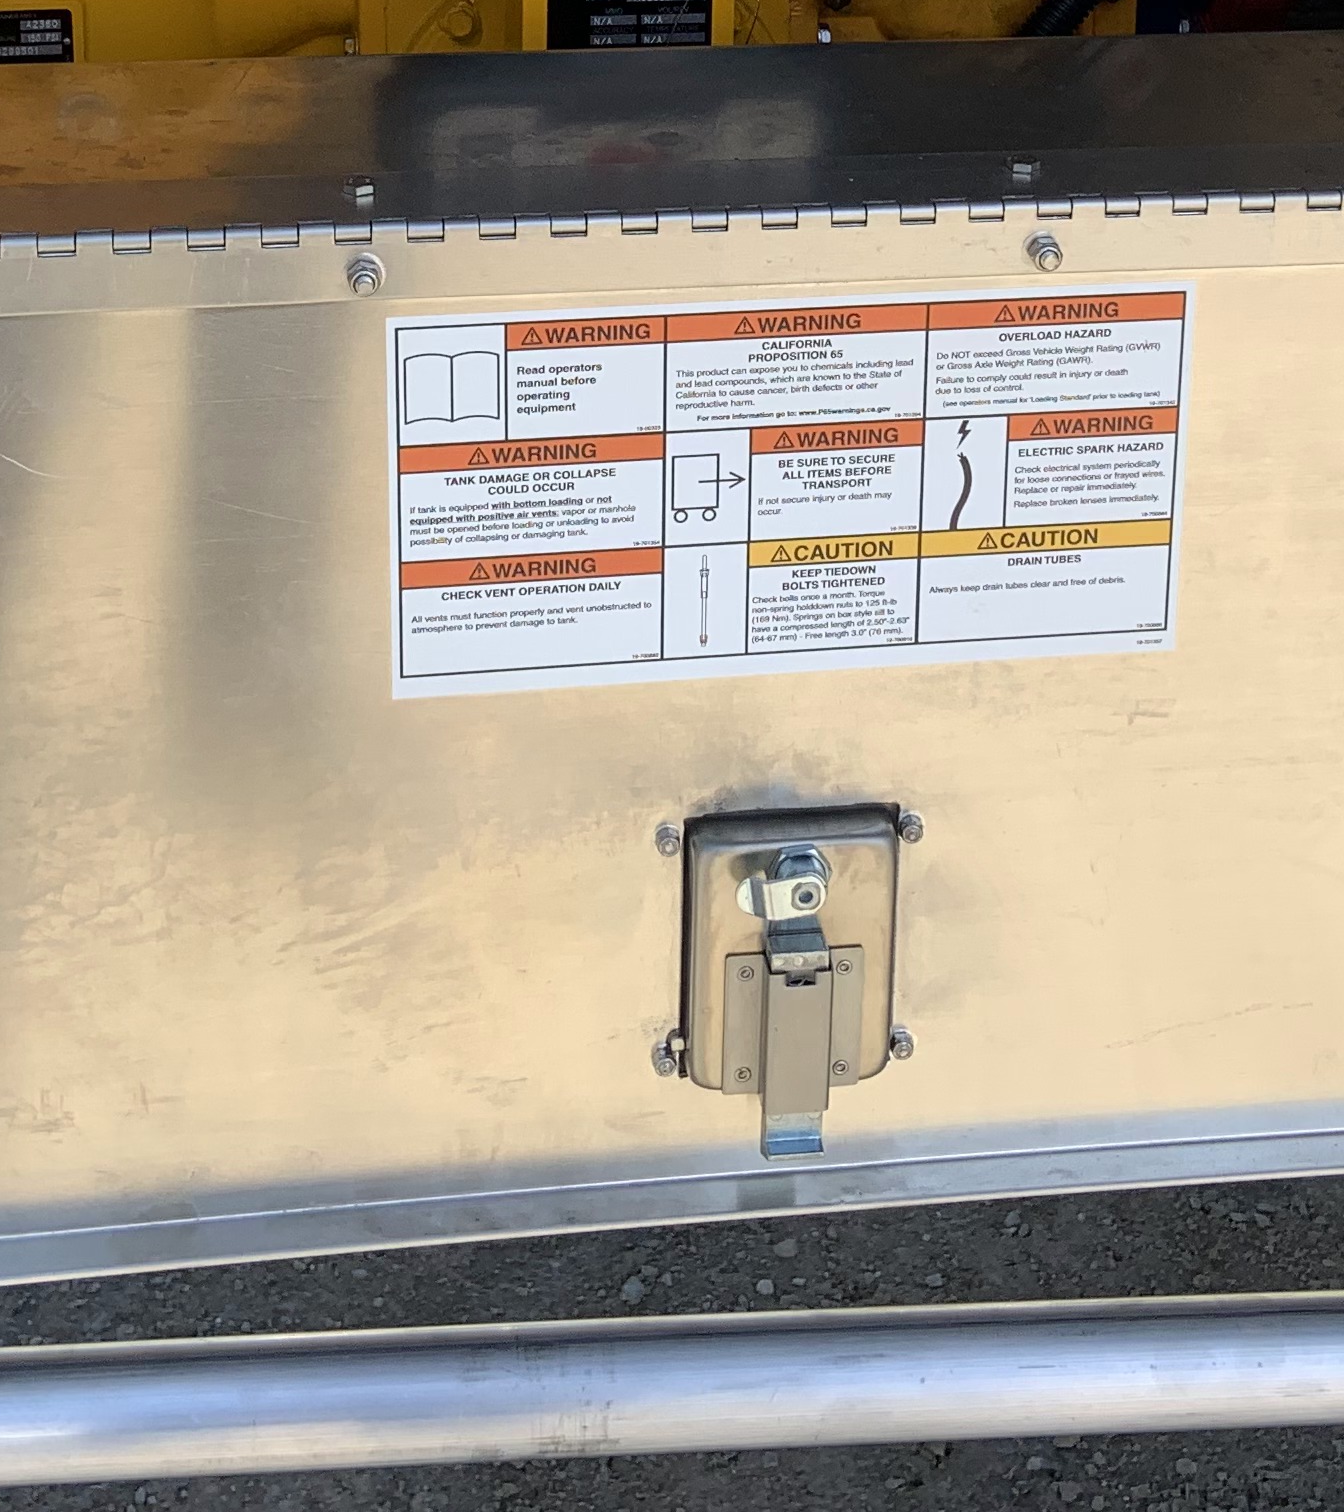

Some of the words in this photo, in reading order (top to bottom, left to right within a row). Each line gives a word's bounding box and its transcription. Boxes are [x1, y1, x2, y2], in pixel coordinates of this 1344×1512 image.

[643, 16, 663, 24] N/A
[593, 37, 613, 45] N/A
[643, 36, 664, 44] N/A
[1016, 300, 1119, 322] WARNING
[758, 312, 861, 334] WARNING
[544, 322, 651, 344] WARNING
[998, 329, 1062, 342] OVERLOAD
[1063, 327, 1112, 339] HAZARD
[761, 337, 833, 351] CALIFORNIA
[747, 349, 827, 363] PROPOSITION
[829, 349, 843, 359] 65
[516, 364, 545, 375] Read
[548, 362, 602, 376] operators
[516, 376, 557, 388] manual
[560, 374, 596, 386] before
[516, 389, 570, 403] operating
[516, 401, 576, 416] equipment
[1052, 414, 1154, 435] WARNING
[795, 426, 899, 448] WARNING
[491, 441, 597, 464] WARNING
[1017, 445, 1074, 458] ELECTRIC
[1076, 443, 1114, 455] SPARK
[1116, 441, 1164, 453] HAZARD
[778, 458, 794, 468] BE
[796, 456, 829, 468] SURE
[829, 455, 846, 466] TO
[848, 453, 895, 465] SECURE
[443, 475, 476, 486] TANK
[478, 472, 529, 484] DAMAGE
[532, 471, 550, 481] OR
[553, 467, 616, 480] COLLAPSE
[781, 469, 804, 480] ALL
[806, 467, 842, 479] ITEMS
[844, 464, 892, 477] BEFORE
[487, 483, 529, 496] COULD
[531, 481, 574, 493] OCCUR
[801, 477, 872, 490] TRANSPORT
[757, 497, 764, 505] If
[765, 496, 779, 505] not
[780, 496, 810, 504] secure
[811, 493, 835, 504] injury
[836, 493, 846, 501] or
[847, 491, 872, 500] death
[873, 491, 892, 501] may
[999, 527, 1098, 549] CAUTION
[793, 539, 893, 562] CAUTION
[491, 556, 596, 579] WARNING
[1007, 555, 1042, 567] DRAIN
[1043, 553, 1082, 565] TUBES
[791, 568, 822, 578] KEEP
[823, 564, 876, 577] TIEDOWN
[440, 589, 482, 601] CHECK
[484, 587, 516, 598] VENT
[518, 582, 585, 596] OPERATION
[588, 580, 621, 592] DAILY
[781, 579, 819, 591] BOLTS
[820, 575, 885, 589] TIGHTENED
[928, 584, 958, 596] Always
[959, 583, 981, 593] keep
[982, 582, 1003, 591] drain
[1004, 580, 1028, 590] tubes
[1029, 579, 1051, 588] clear
[1052, 578, 1069, 587] and
[1069, 577, 1087, 586] free
[1087, 576, 1097, 585] of
[1097, 575, 1126, 585] debris.
[410, 615, 423, 624] All
[424, 613, 448, 623] vents
[449, 612, 471, 621] must
[473, 609, 508, 620] function
[509, 607, 545, 619] properly
[546, 606, 563, 615] and
[565, 605, 584, 614] vent
[585, 601, 641, 613] unobstructed
[643, 601, 652, 609] to
[410, 623, 463, 635] atmosphere
[464, 622, 474, 631] to
[475, 620, 508, 631] prevent
[509, 618, 545, 629] damage
[546, 617, 555, 625] to
[556, 615, 578, 624] tank.
